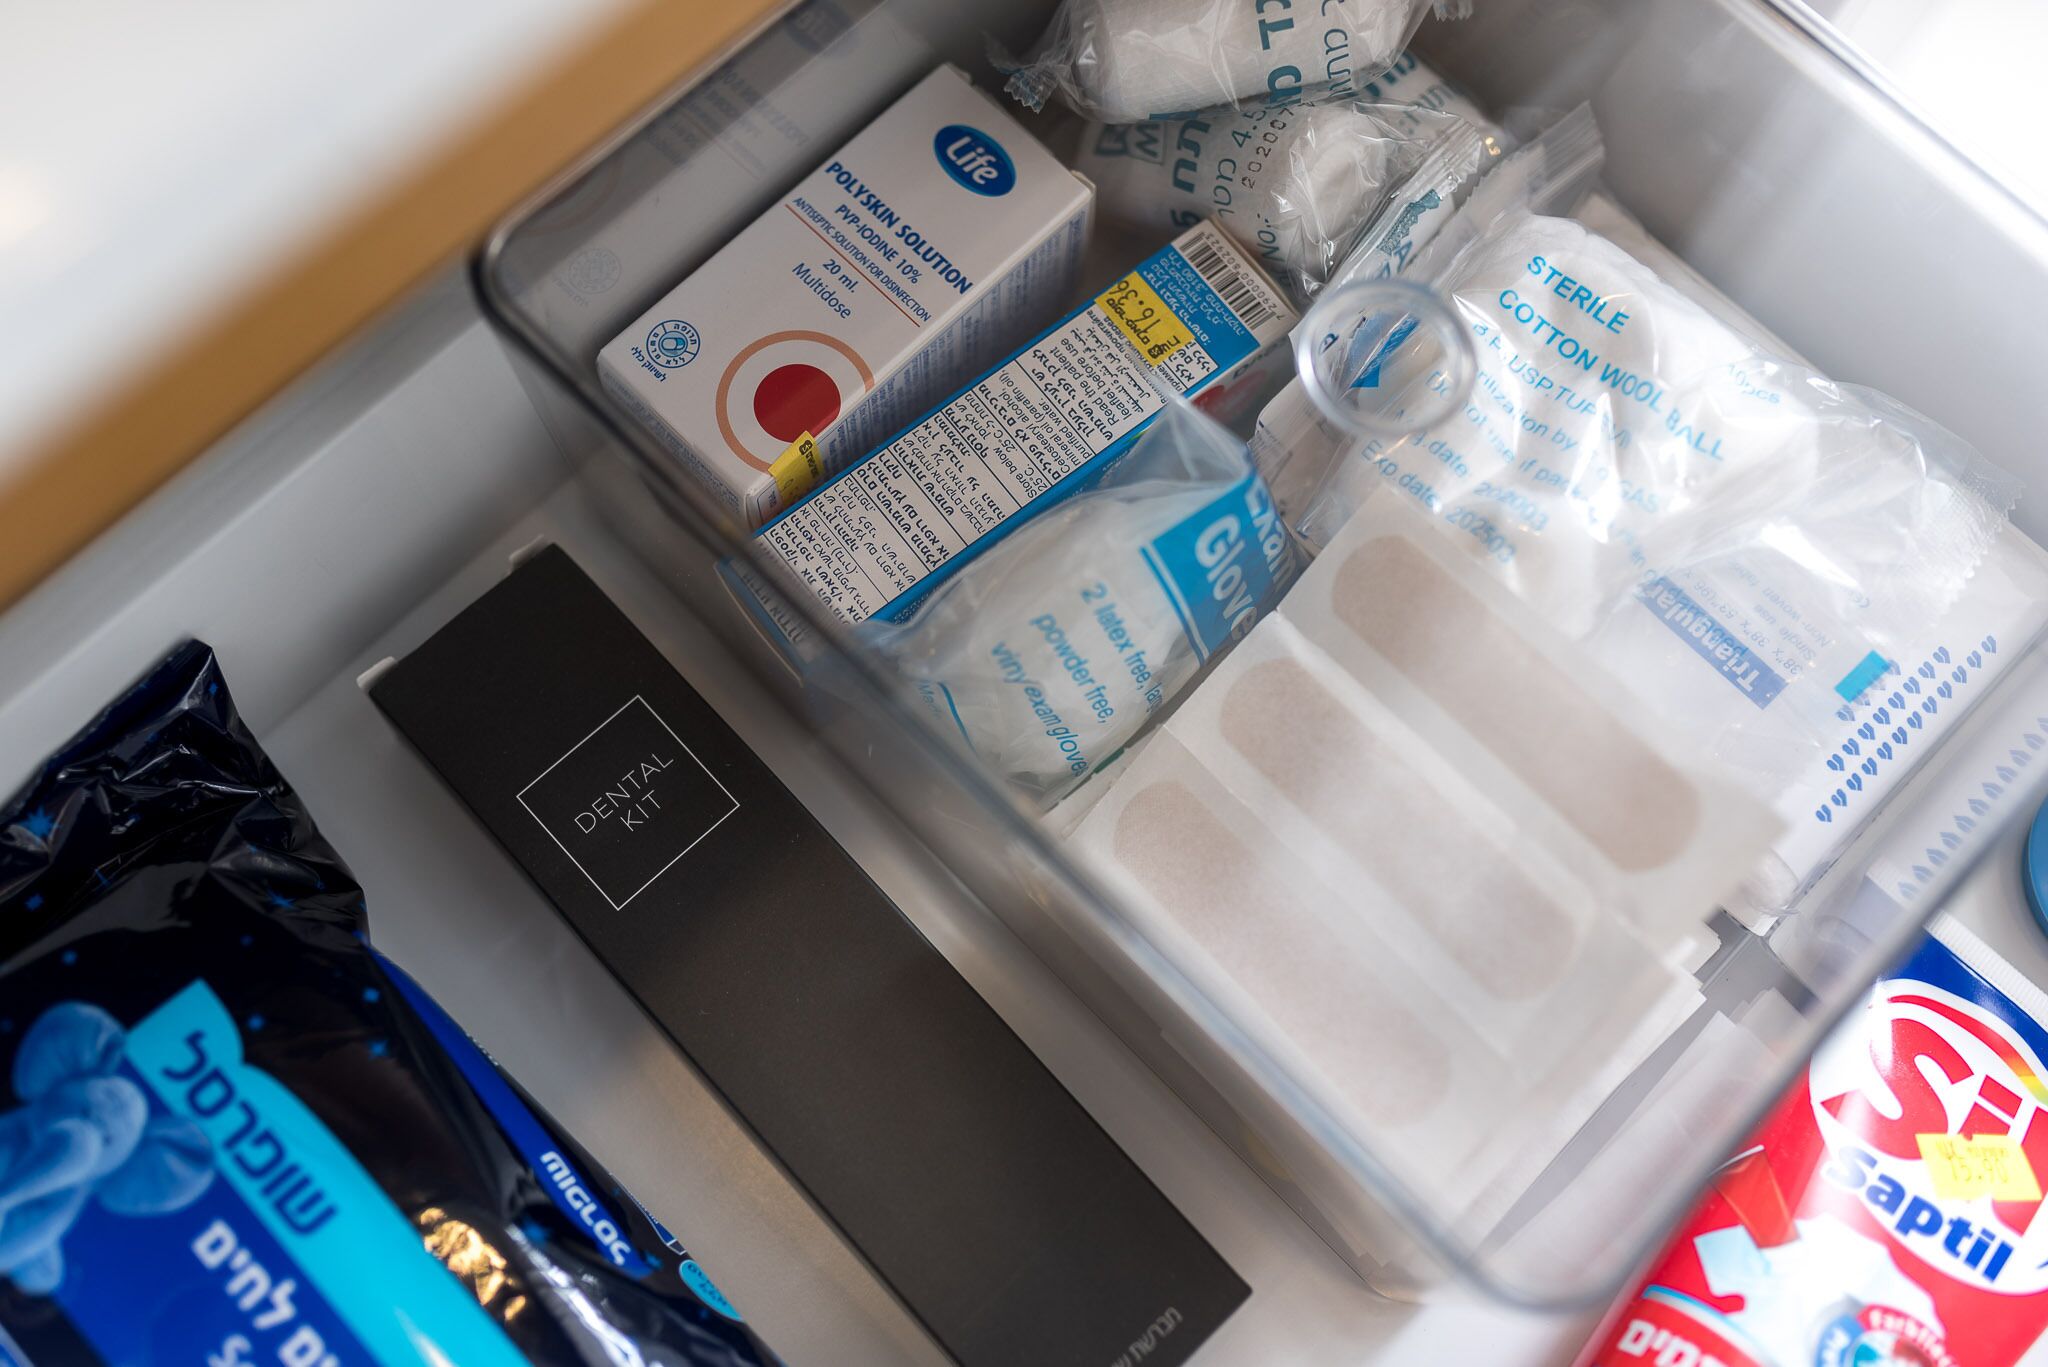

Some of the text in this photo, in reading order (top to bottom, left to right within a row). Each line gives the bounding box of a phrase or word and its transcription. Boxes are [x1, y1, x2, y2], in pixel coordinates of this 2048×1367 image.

[944, 131, 1003, 188] Life
[793, 197, 835, 234] ANTISEPTIC
[831, 231, 870, 266] SOLUTION
[866, 262, 883, 279] FOR
[880, 275, 931, 322] DISINFECTION
[825, 161, 899, 228] POLYSKIN
[895, 224, 972, 294] SOLUTION
[835, 204, 922, 284] PVP-IODINE 10%
[792, 262, 852, 319] Multidose
[822, 258, 859, 293] 20 ml.
[1109, 277, 1160, 334] 16.36
[1527, 255, 1629, 334] STERILE
[1086, 309, 1125, 353] прочитайте
[1192, 349, 1211, 372] כללי
[964, 393, 987, 419] מתחת
[998, 369, 1081, 466] mineral oil (paraffin oil),
[1031, 367, 1095, 437] יש לעיין בעלון
[1032, 348, 1113, 441] לצרכן לפני השימוש
[1049, 345, 1119, 426] Read the patient
[1060, 337, 1131, 420] leaflet before use
[1498, 289, 1598, 371] COTTON
[1596, 354, 1672, 420] WOOL
[1661, 405, 1732, 466] BALL
[933, 415, 970, 457] המומלצת.
[945, 407, 989, 458] מידע נוסף
[954, 401, 991, 440] יש לאחסן
[978, 383, 1061, 481] מרכיבים לא פעילים
[998, 388, 1071, 474] Cetostearyl alcohol,
[1038, 398, 1092, 460] purified water.
[1549, 426, 1580, 455] by
[843, 477, 875, 512] בתרופה.
[878, 452, 902, 479] רוקח
[892, 443, 954, 515] הוראות שימוש
[902, 437, 985, 534] יש למרוח את הקרם בשכבה
[912, 425, 995, 525] דקה על האזור הנגוע.
[922, 419, 1005, 520] אין לעבור על המנה
[993, 447, 1037, 498] Store below
[1023, 464, 1047, 491] 25°C.
[799, 507, 858, 575] או פריחה (נדיר).
[813, 497, 837, 523] הריון
[834, 522, 859, 552] והנקה
[823, 492, 905, 591] יש להתייעץ עם רופא או
[833, 483, 856, 509] רוקח
[858, 515, 877, 538] לפני
[881, 543, 916, 584] השימוש
[856, 468, 941, 567] טרם השימוש מומלץ
[866, 460, 949, 559] להתייעץ עם רופא או
[769, 528, 816, 585] הפסק/י את
[780, 521, 862, 623] בתרופה ושאל/י את
[790, 514, 870, 615] הרופא כאשר מופיע גירוי
[1027, 605, 1118, 726] powder free,
[1078, 580, 1157, 691] 2 latex free,
[1640, 577, 1768, 693] Triangular
[1775, 623, 1818, 664] Single
[1022, 679, 1062, 731] exam
[574, 751, 674, 833] DENTAL
[620, 790, 662, 831] KIT
[163, 1030, 340, 1239] שופרסל
[1823, 1144, 2014, 1283] Saptil
[185, 1206, 312, 1341] לחים
